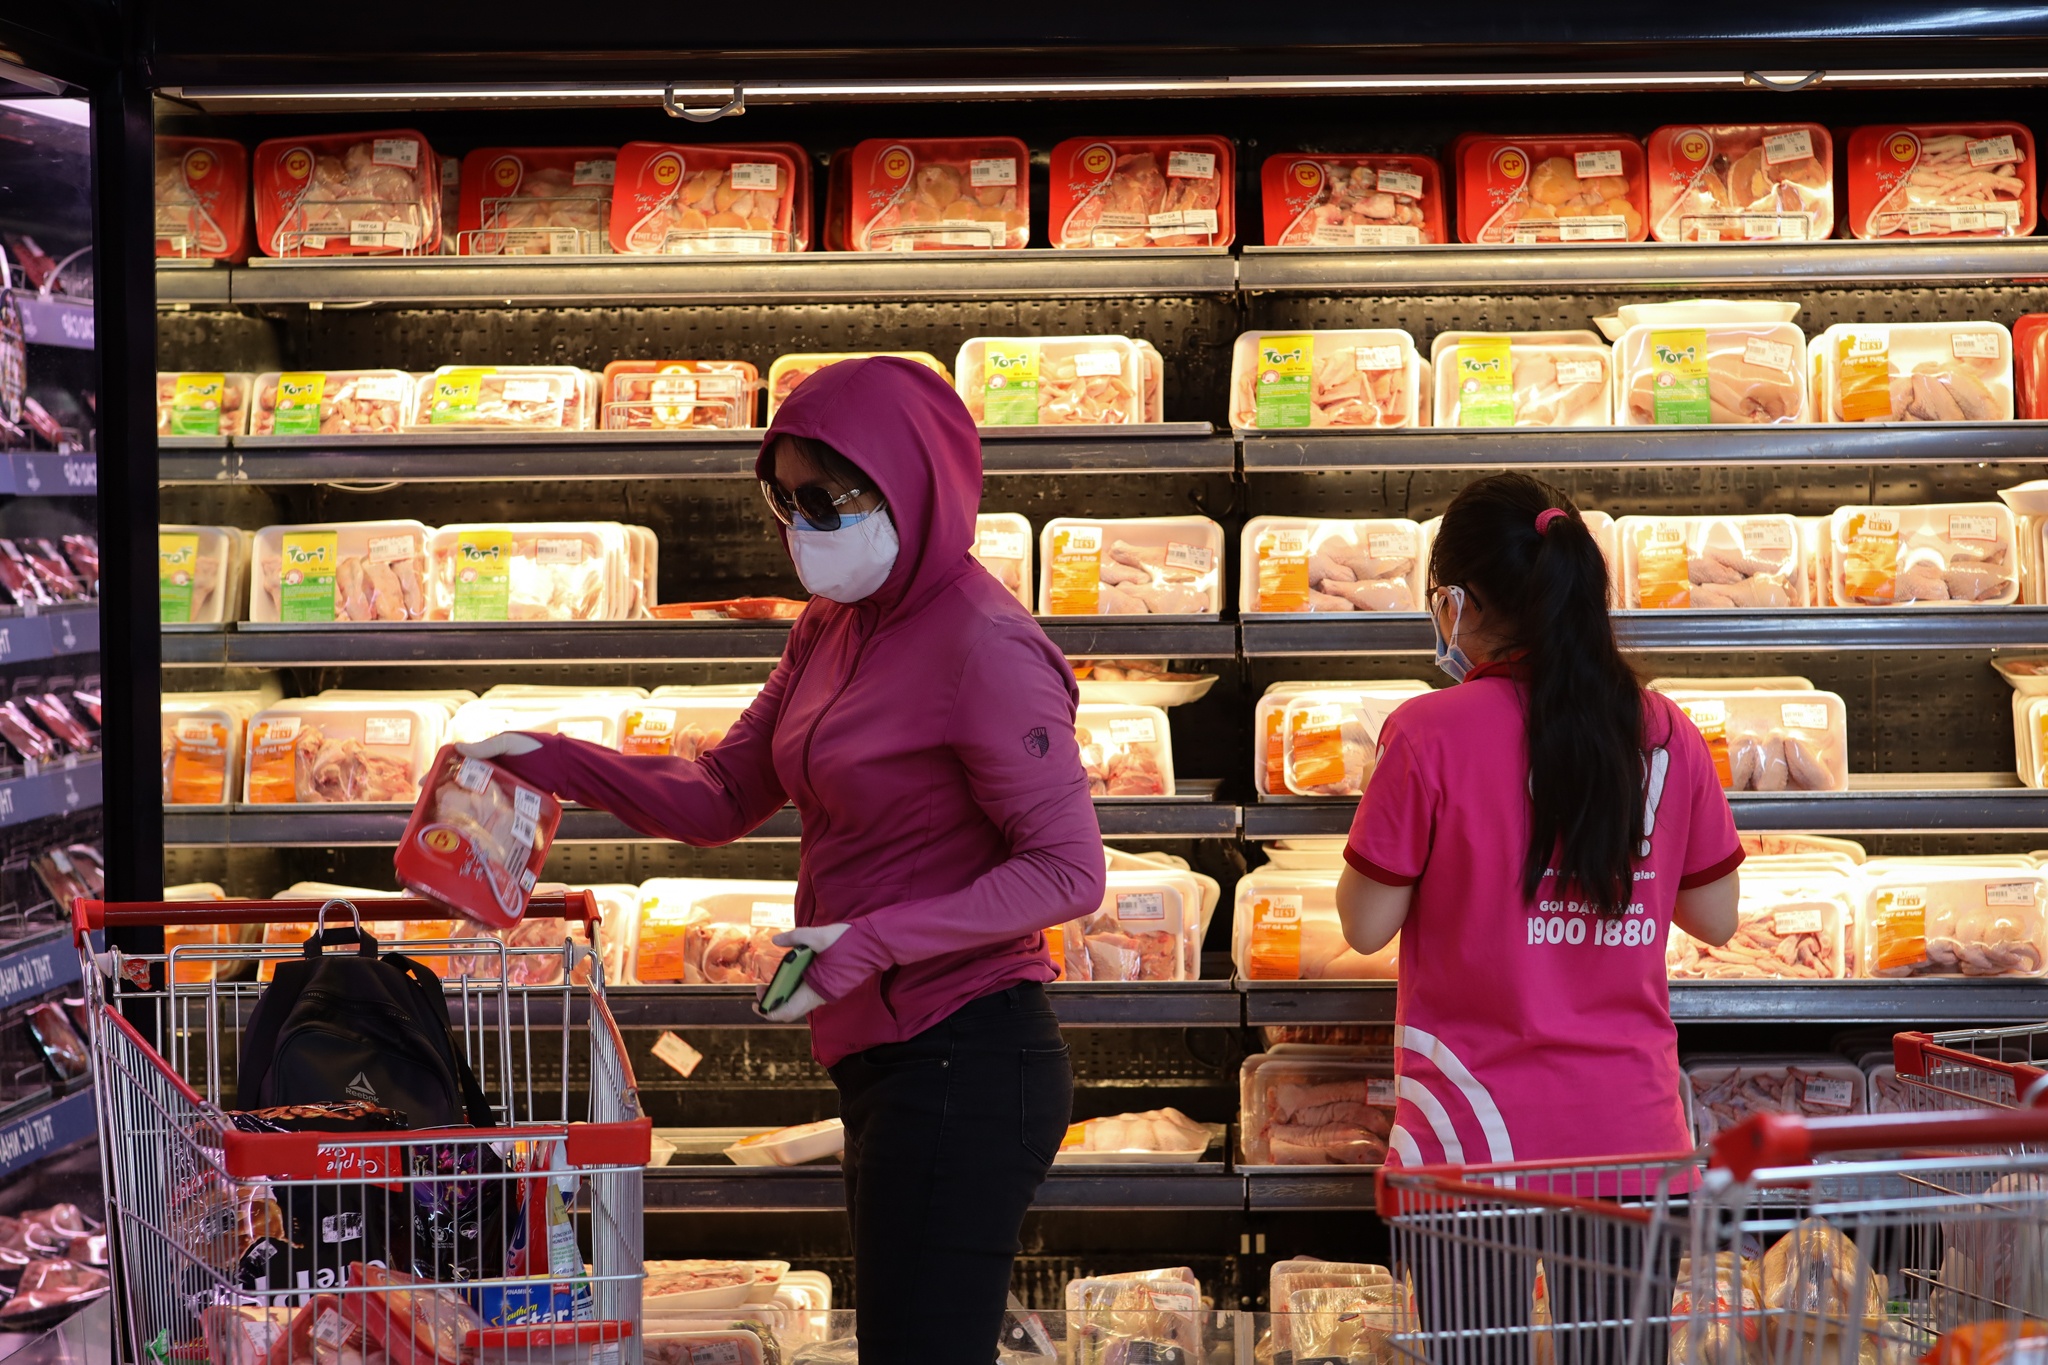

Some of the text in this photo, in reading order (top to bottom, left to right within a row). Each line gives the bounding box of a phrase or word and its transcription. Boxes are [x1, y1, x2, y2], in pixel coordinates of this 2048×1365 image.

[1686, 142, 1703, 153] CP
[1894, 143, 1911, 154] CP
[290, 160, 306, 170] CP
[888, 159, 905, 170] CP
[1088, 155, 1105, 166] CP
[1503, 160, 1520, 170] CP
[498, 168, 514, 179] CP
[658, 165, 673, 177] CP
[1299, 171, 1315, 181] CP
[634, 231, 650, 242] THỊT
[1264, 350, 1301, 364] Tori
[1656, 346, 1695, 364] Tori
[990, 354, 1027, 368] Tori
[1463, 359, 1499, 372] Tori
[282, 383, 314, 395] Tori
[439, 385, 470, 396] Tori
[1074, 540, 1095, 548] BEST
[288, 547, 325, 563] Tori
[462, 545, 499, 561] Tori
[646, 722, 667, 731] BEST
[1633, 871, 1656, 881] giao
[1539, 900, 1564, 914] GỌI
[1274, 909, 1295, 917] BEST
[1527, 916, 1656, 947] 1900 1880
[346, 1087, 380, 1103] Reebok
